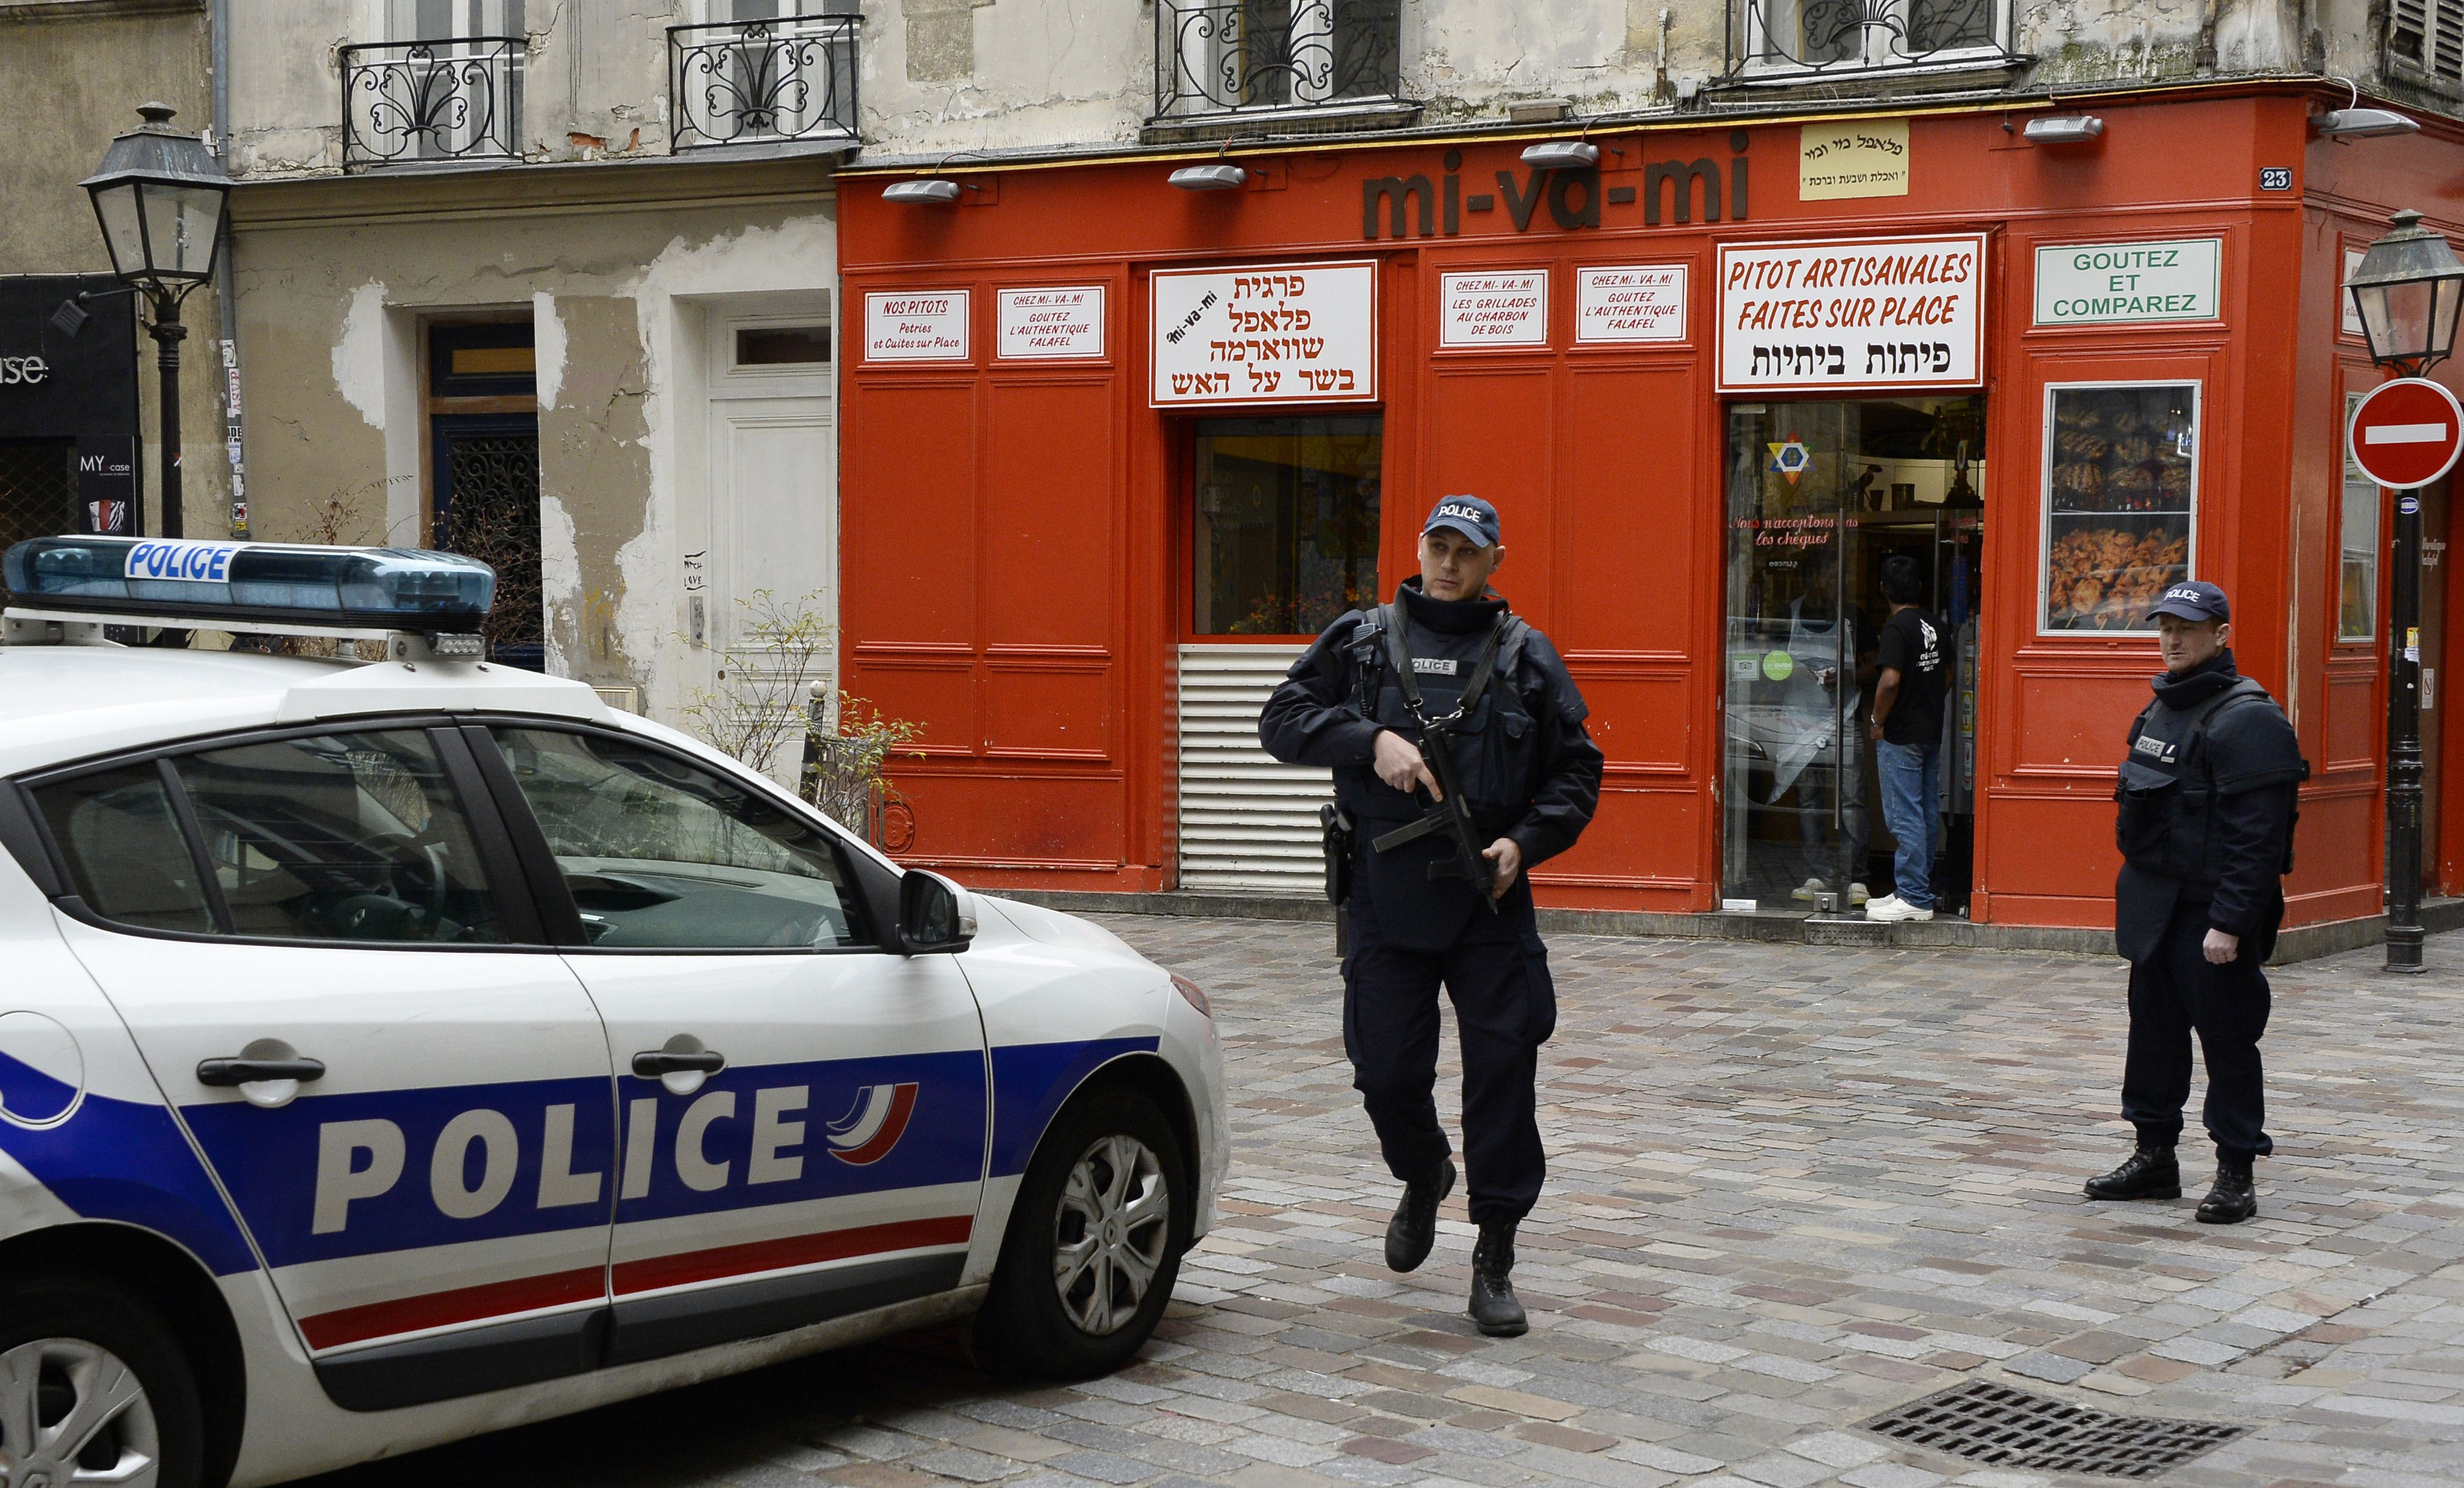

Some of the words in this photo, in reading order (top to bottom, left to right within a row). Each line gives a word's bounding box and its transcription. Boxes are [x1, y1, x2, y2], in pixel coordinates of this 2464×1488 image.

[1832, 138, 1851, 150] מי
[1856, 134, 1903, 156] פלאפל
[1363, 130, 1749, 237] mi-va-mi
[2264, 170, 2287, 187] 23
[2073, 250, 2179, 271] GOUTEZ
[1592, 276, 1617, 286] CHEZ
[1659, 274, 1673, 284] MI
[1728, 259, 1802, 291] PITOT
[1802, 252, 1972, 289] ARTISANALES
[1234, 274, 1305, 300] פרגית
[1456, 280, 1480, 291] CHEZ
[1520, 279, 1534, 289] MI
[2110, 274, 2141, 292] ET
[1014, 296, 1035, 305] CHEZ
[1071, 294, 1084, 303] MI
[1452, 299, 1472, 309] LES
[1476, 297, 1537, 309] GRILLADES
[1608, 292, 1656, 303] GOUTEZ
[2053, 294, 2196, 316] COMPAREZ
[883, 302, 905, 315] NOS
[909, 299, 949, 314] PITOTS
[1585, 305, 1678, 317] L'AUTHENTIQUE
[1738, 299, 1823, 331] FAITES
[1825, 297, 1875, 328] SUR
[1880, 294, 1959, 326] PLACE
[1029, 312, 1071, 323] GOUTEZ
[1166, 290, 1217, 345] mi-va-mi
[1228, 300, 1311, 333] פלאפל
[1457, 312, 1474, 322] AU
[1475, 311, 1529, 322] CHARBON
[1607, 319, 1656, 330] FALAFEL
[899, 322, 932, 334] Petries
[1010, 323, 1090, 336] L'AUTHENTIQUE
[1471, 325, 1486, 335] DE
[1488, 324, 1514, 334] BOIS
[874, 340, 883, 350] et
[885, 338, 915, 349] Cuites
[934, 336, 960, 348] Place
[1029, 337, 1071, 348] FALAFEL
[1210, 337, 1324, 362] שווארמה
[1750, 343, 1845, 376] ביתיות
[1866, 341, 1951, 374] פיתות
[0, 356, 46, 384] se
[1248, 362, 1281, 393] על
[1171, 372, 1230, 394] האש
[1299, 368, 1355, 391] בשר
[1437, 504, 1481, 522] POLICE
[1729, 515, 1760, 529] Nous
[1763, 514, 1833, 533] n'acceptons
[1755, 531, 1773, 546] les
[129, 544, 236, 581] POLICE
[684, 575, 702, 587] LOVE
[2165, 589, 2201, 603] POLICE
[1413, 661, 1450, 671] OLICE
[2139, 738, 2161, 756] POLICE
[312, 1084, 808, 1236] POLICE
